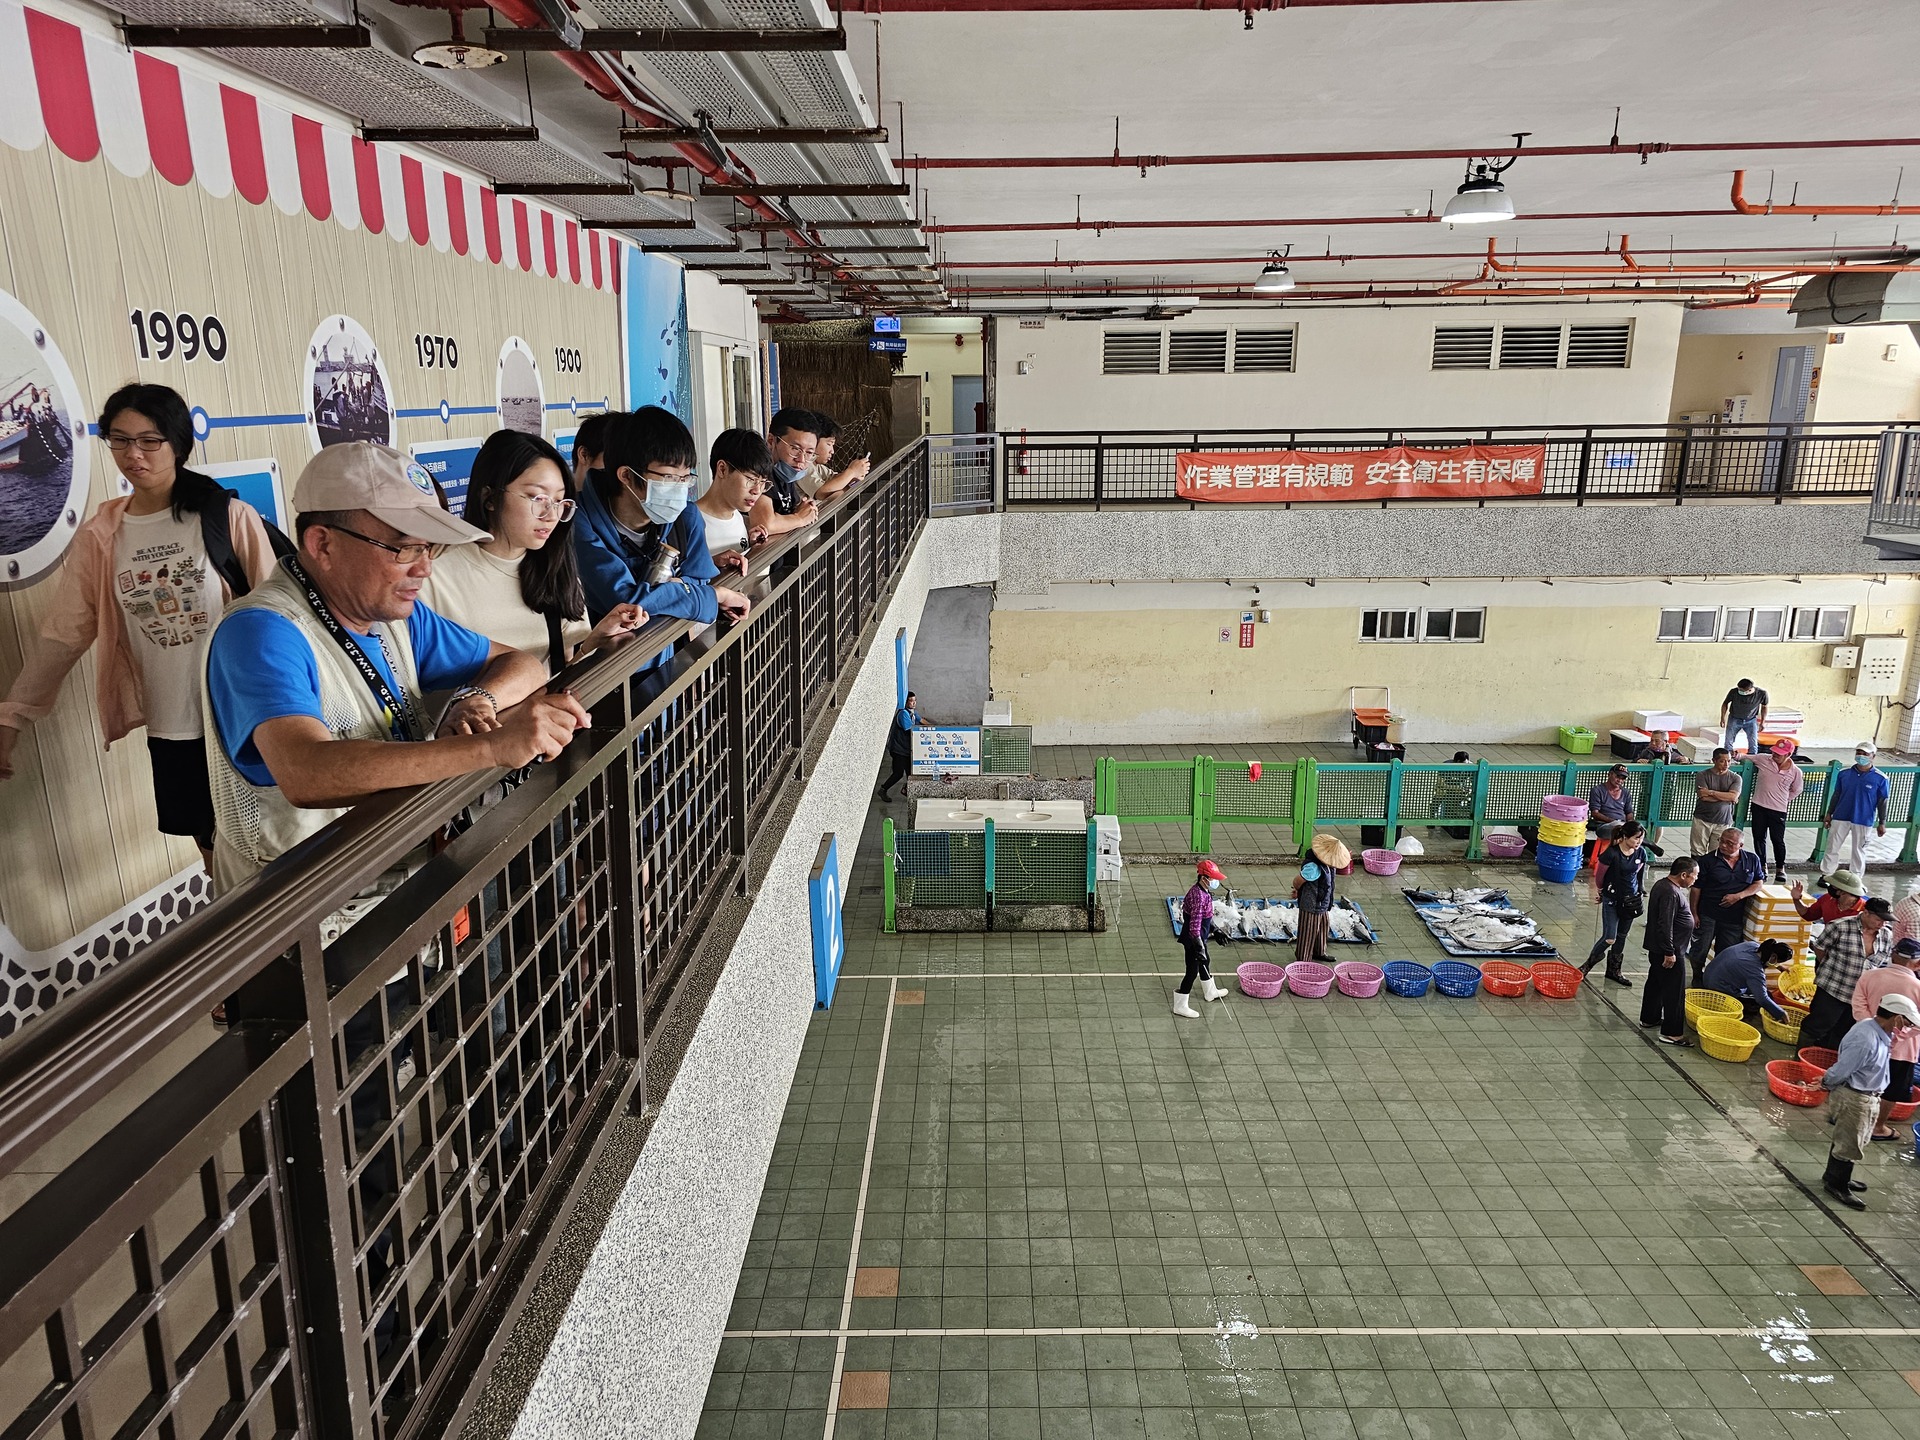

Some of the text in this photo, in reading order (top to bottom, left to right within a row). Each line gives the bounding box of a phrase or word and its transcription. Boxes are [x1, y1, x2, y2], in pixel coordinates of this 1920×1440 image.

[130, 308, 228, 363] 1990
[414, 333, 459, 370] 1970
[554, 346, 583, 374] 1900
[1183, 457, 1537, 490] 作業管理有規範 安全衛生有保障
[826, 873, 840, 975] 2
